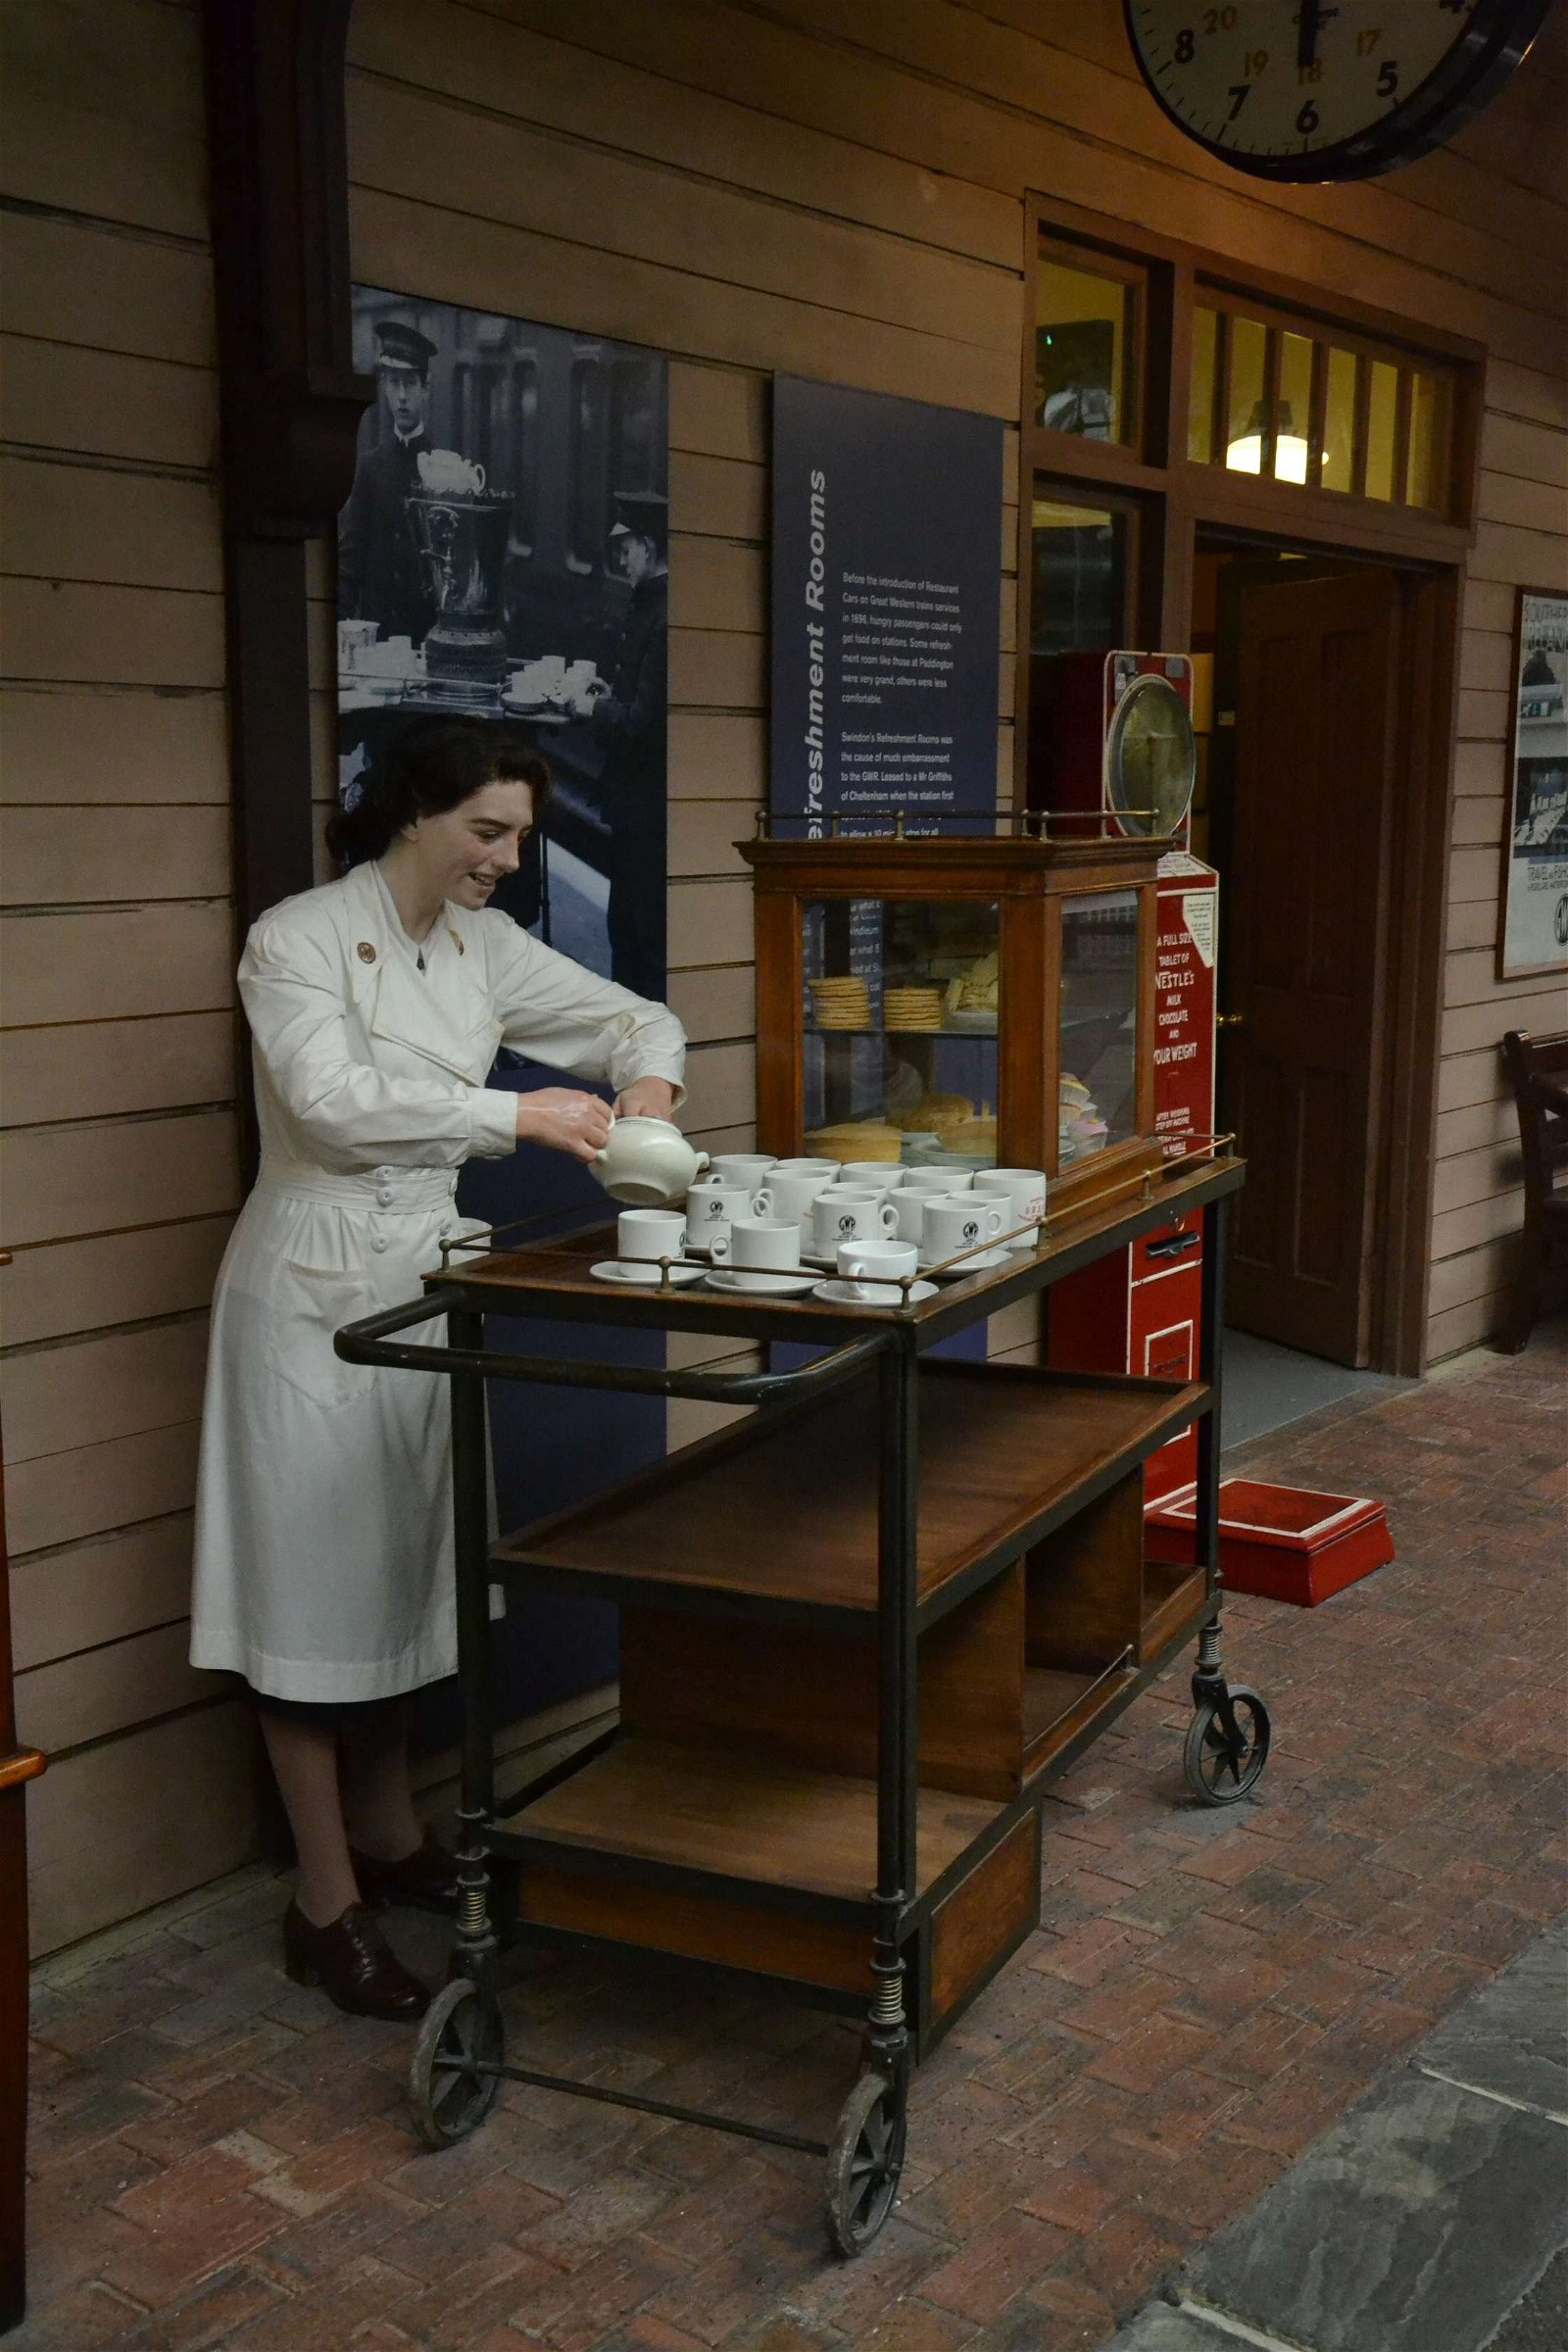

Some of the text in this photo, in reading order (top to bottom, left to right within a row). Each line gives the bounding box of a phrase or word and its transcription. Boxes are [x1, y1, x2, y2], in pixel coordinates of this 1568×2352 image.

[1202, 5, 1238, 35] 20
[1173, 29, 1195, 64] 8
[1356, 28, 1383, 57] 17
[1245, 50, 1269, 77] 19
[1376, 61, 1397, 97] 5
[1228, 85, 1250, 121] 7
[1297, 99, 1319, 133] 6
[843, 571, 958, 594] Before the introduction of Restaurant
[843, 592, 960, 613] Cars on Great Western trains services
[869, 614, 892, 628] hungry
[894, 618, 930, 630] passengers
[931, 621, 949, 631] could
[949, 622, 961, 633] only
[843, 634, 854, 645] get
[855, 634, 870, 645] food
[871, 636, 880, 645] on
[909, 637, 928, 649] Some
[804, 468, 826, 839] efreshment Rooms
[843, 654, 859, 663] ment
[860, 655, 878, 664] room
[879, 655, 892, 665] like
[892, 656, 910, 666] those
[919, 658, 955, 670] Paddington
[843, 674, 858, 683] were
[859, 675, 874, 685] very
[896, 676, 917, 686] others
[917, 678, 933, 687] were
[934, 678, 948, 688] less
[841, 731, 953, 745] Swindon's Refreshment Rooms was
[841, 752, 951, 763] the cause of much embarrassment
[841, 772, 849, 782] to
[849, 771, 860, 781] the
[880, 771, 904, 782] Leased
[906, 772, 912, 782] to
[919, 771, 927, 781] Mr
[841, 790, 955, 801] of Cheltenham when the station first
[1156, 936, 1162, 948] A
[1163, 934, 1178, 946] FULL
[1158, 953, 1190, 967] TABLET OF
[1166, 994, 1182, 1006] MILK
[1158, 1009, 1188, 1026] CHOCOLATE
[1169, 1029, 1180, 1039] AND
[1171, 1042, 1198, 1061] WEIGHT
